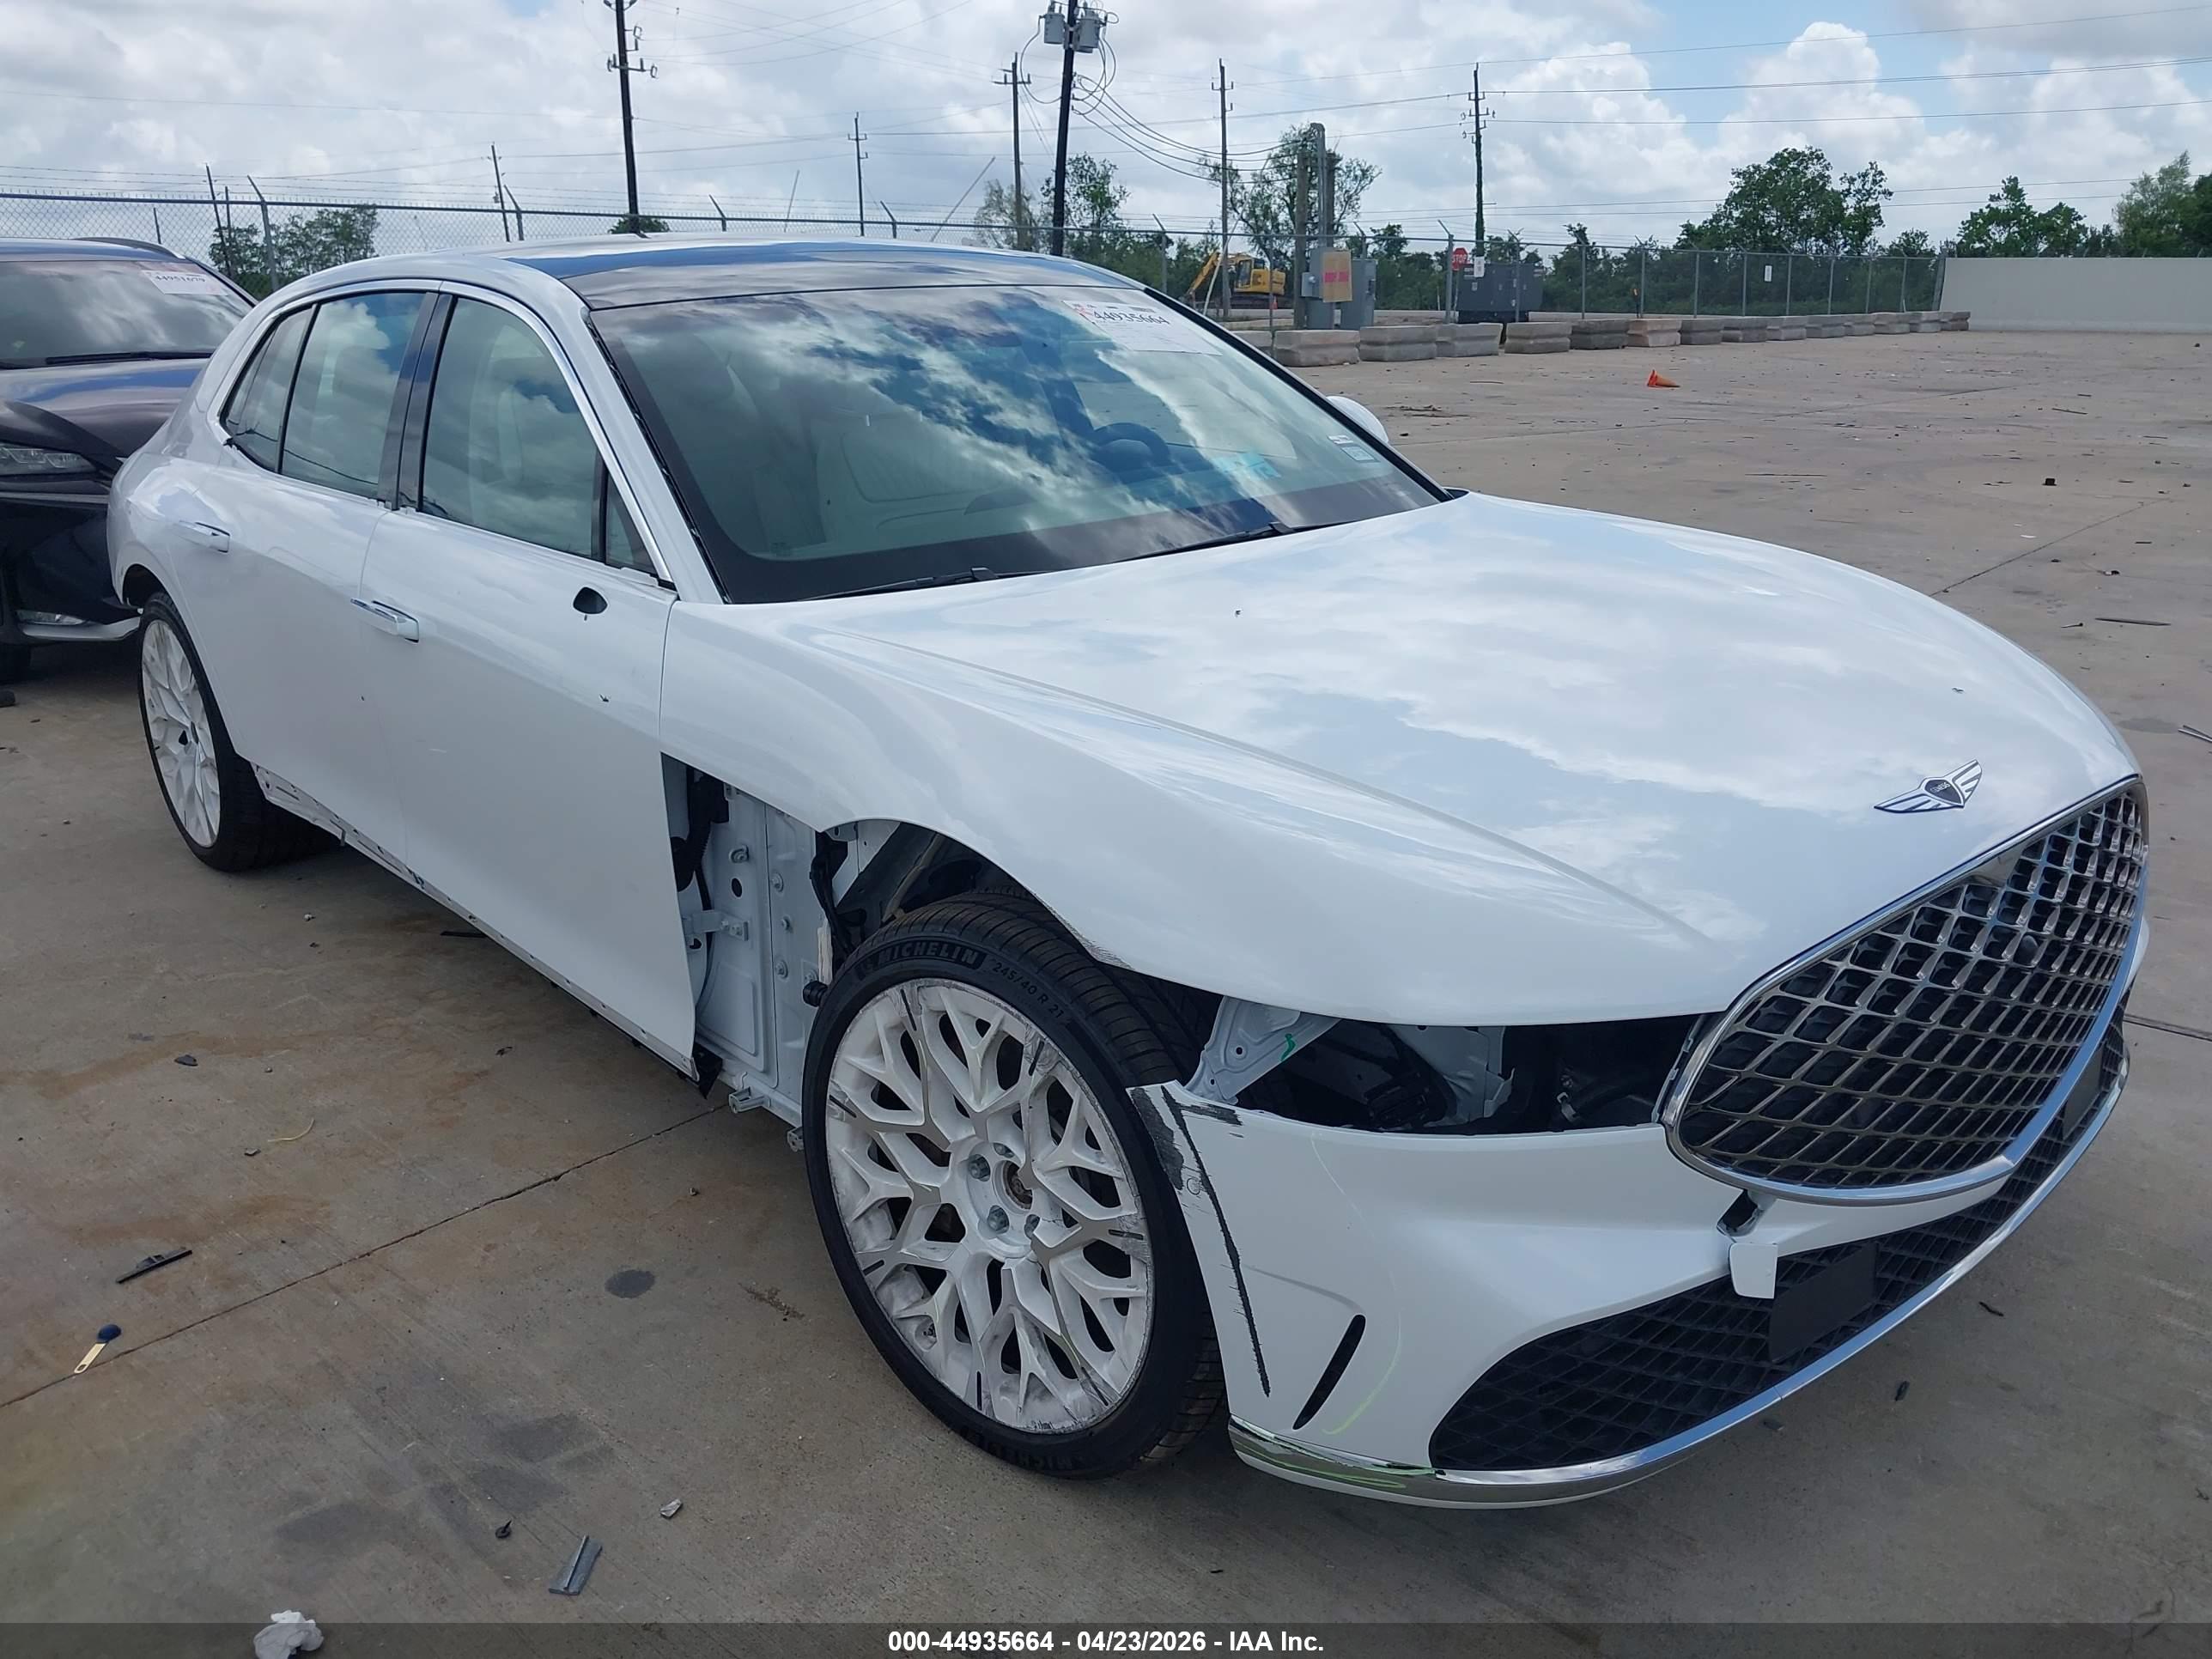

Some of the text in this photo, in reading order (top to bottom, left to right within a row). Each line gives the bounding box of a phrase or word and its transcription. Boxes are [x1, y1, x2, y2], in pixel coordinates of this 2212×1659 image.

[1452, 254, 1467, 263] STOP
[1094, 311, 1170, 325] 44935664
[878, 940, 978, 965] MICHELIN
[993, 962, 1065, 1018] 245/40 R 21
